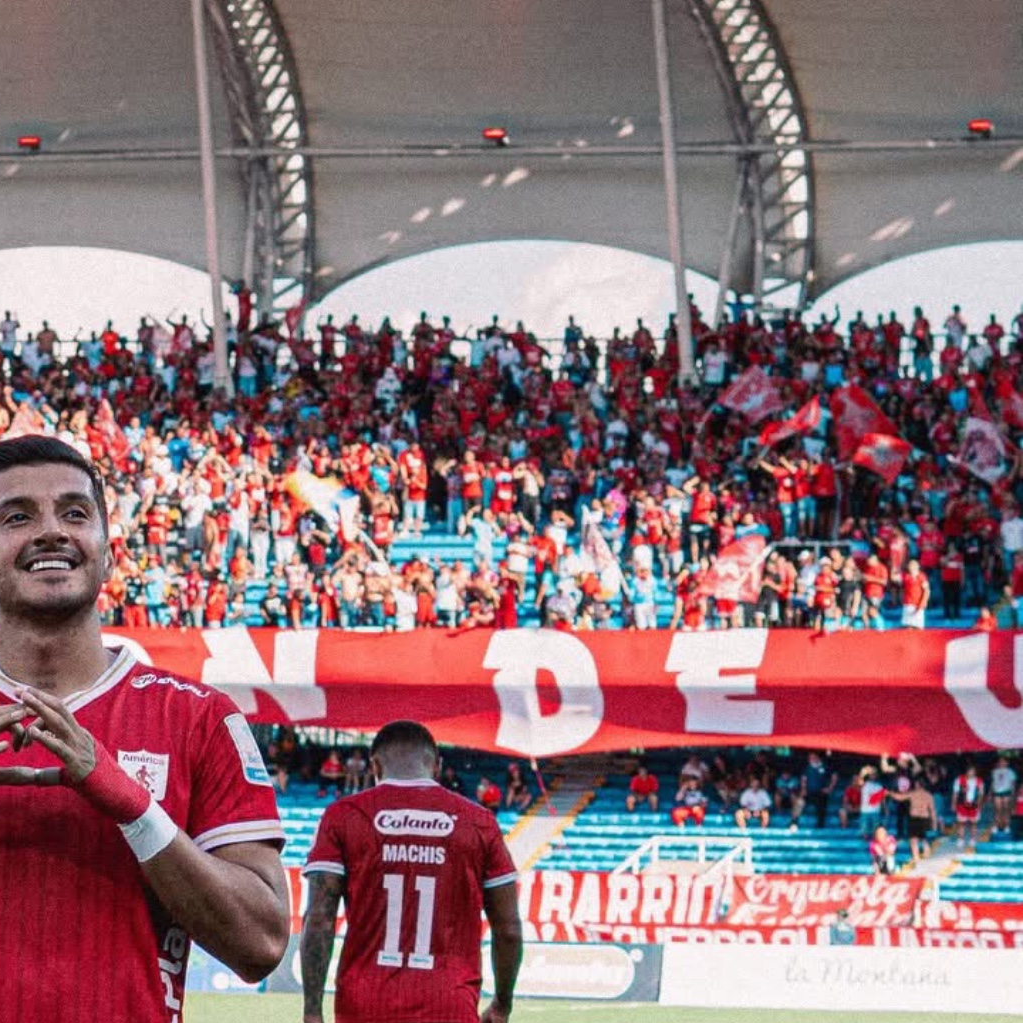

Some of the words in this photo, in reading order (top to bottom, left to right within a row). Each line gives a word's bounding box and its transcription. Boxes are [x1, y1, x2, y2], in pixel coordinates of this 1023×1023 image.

[483, 627, 774, 756] DE
[377, 813, 450, 831] Colanta
[382, 843, 446, 865] MACHIS
[377, 873, 436, 970] 11
